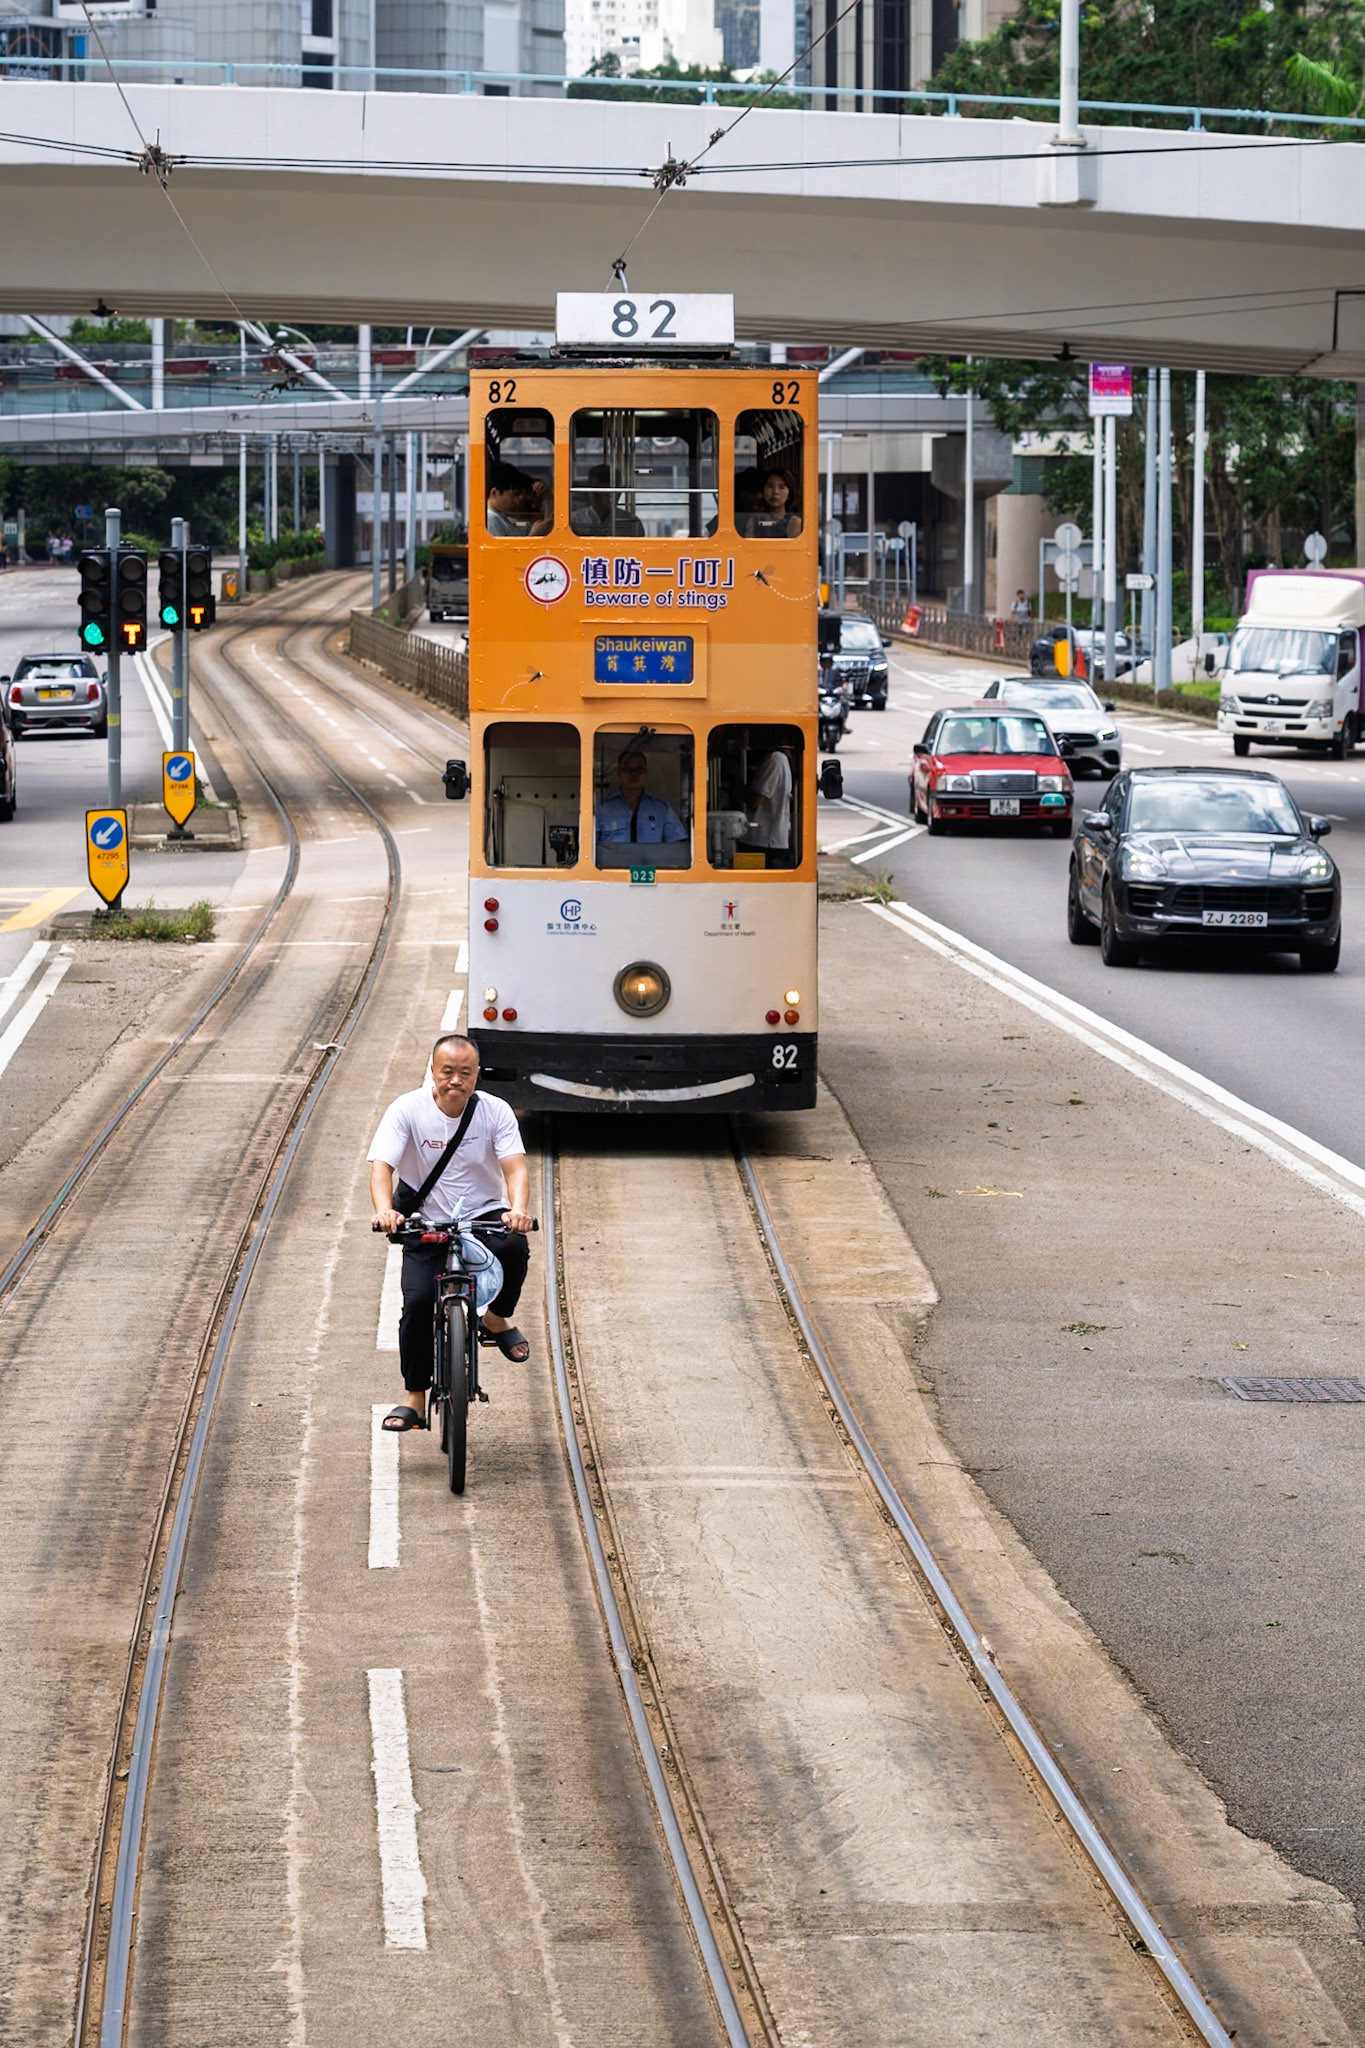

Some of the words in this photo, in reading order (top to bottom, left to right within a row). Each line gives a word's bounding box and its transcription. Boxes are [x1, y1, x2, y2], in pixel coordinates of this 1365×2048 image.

[611, 299, 677, 338] 82
[488, 379, 516, 403] 82
[771, 381, 800, 405] 82
[585, 590, 649, 605] Beware
[656, 590, 673, 605] of
[678, 590, 726, 609] stings
[596, 637, 687, 653] Shaukeiwan
[632, 870, 655, 881] 023
[1206, 912, 1224, 924] ZJ
[1229, 913, 1264, 925] 2289
[772, 1044, 798, 1068] 82
